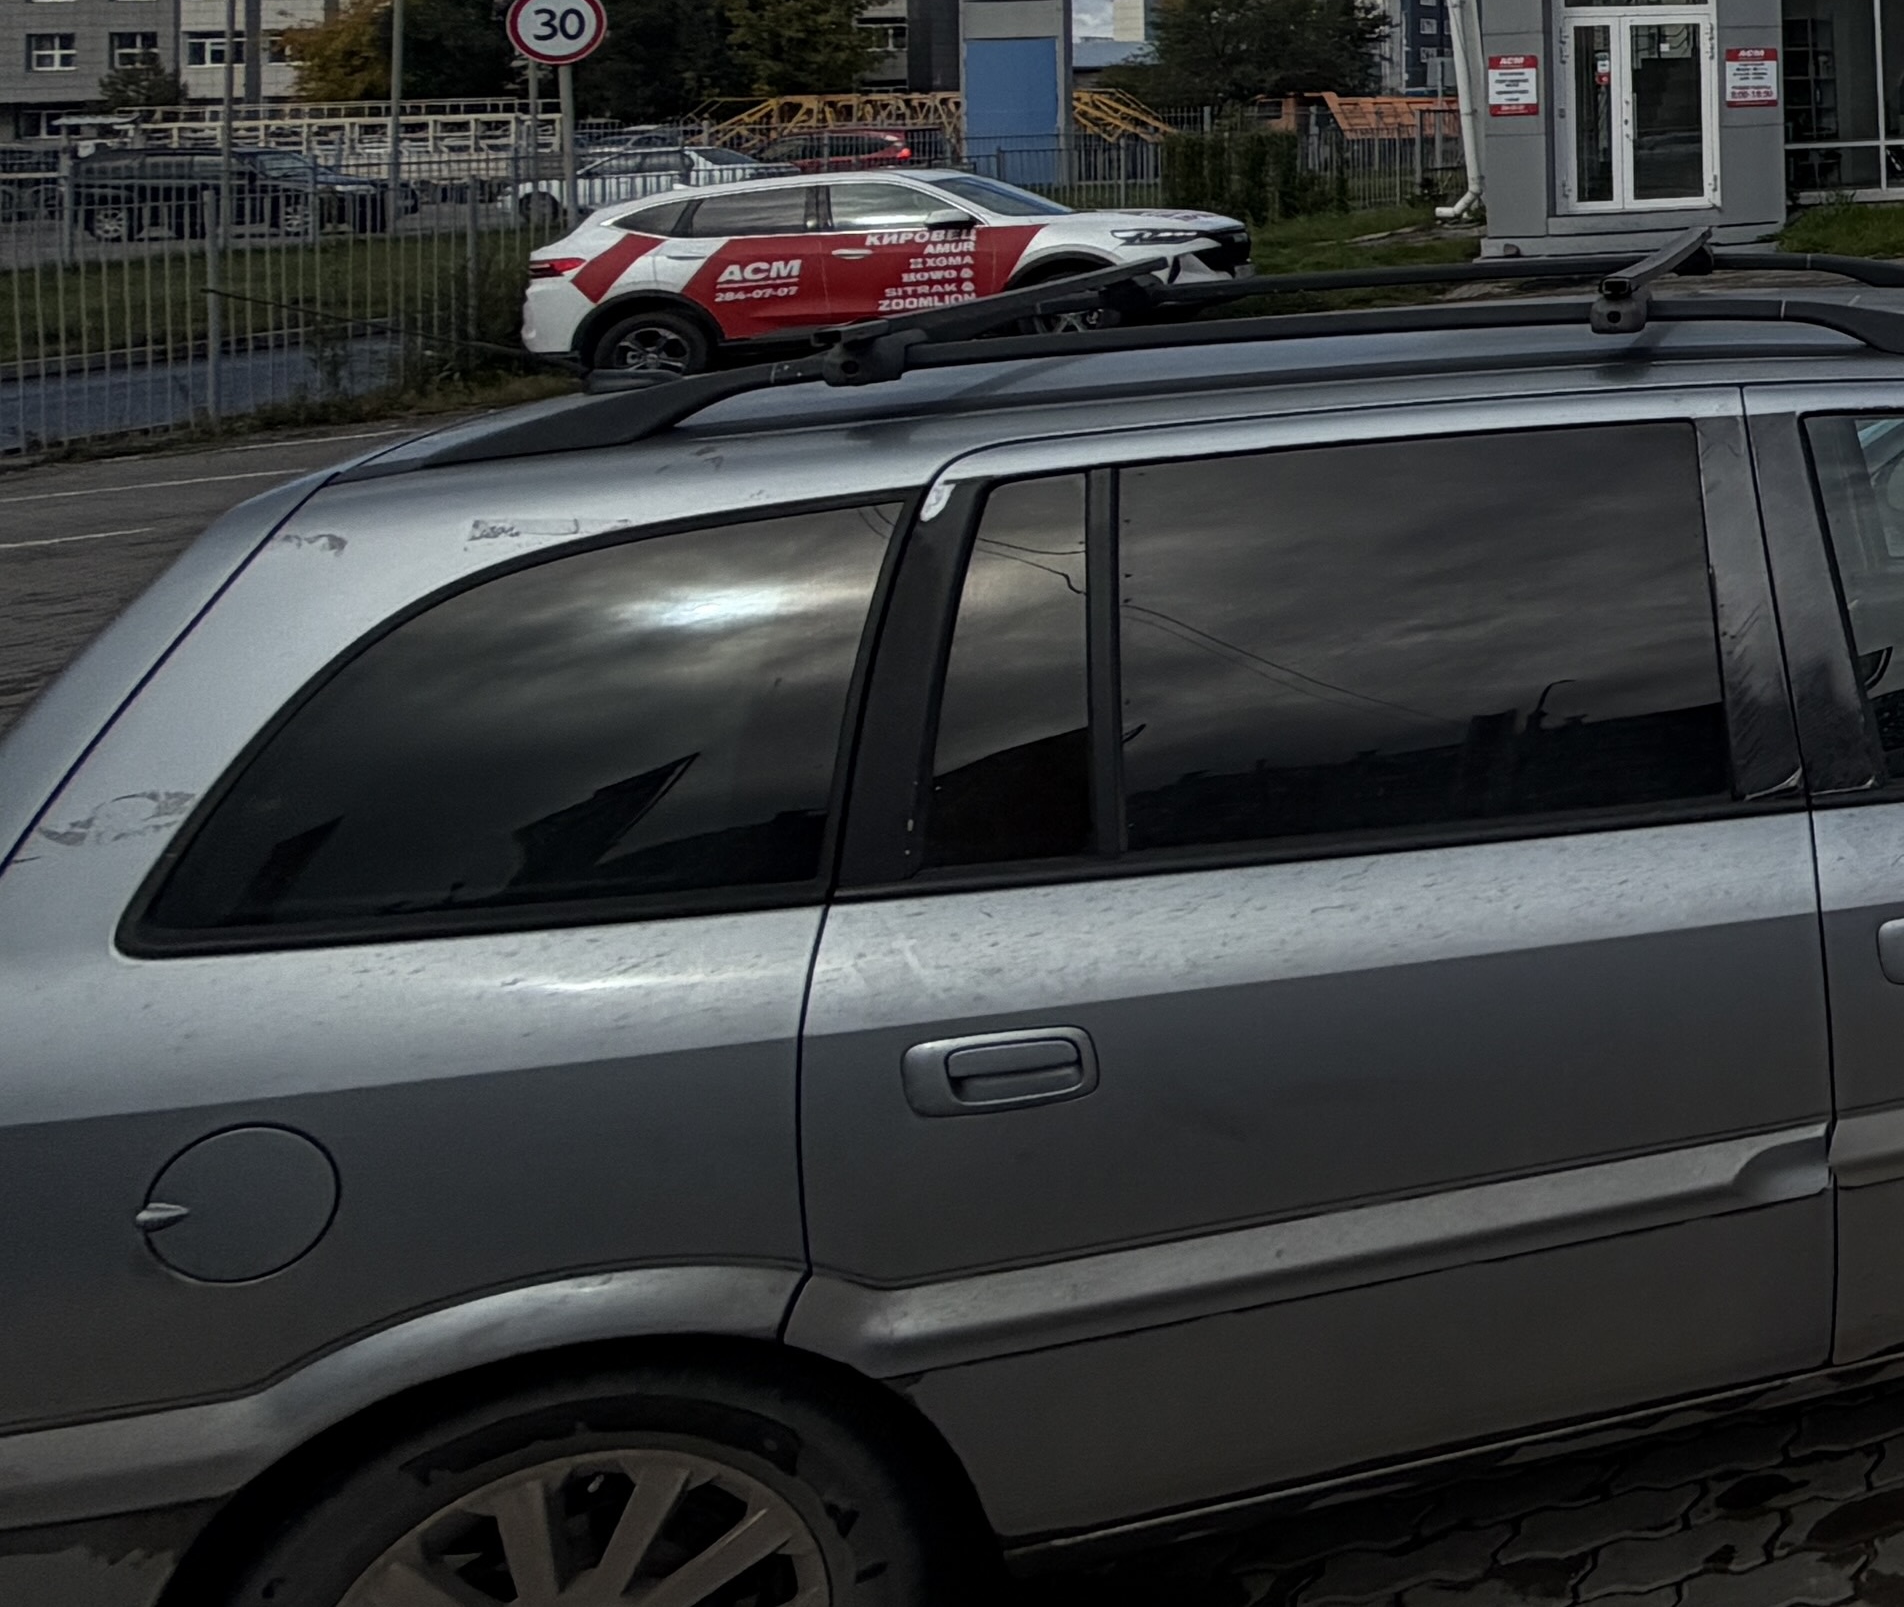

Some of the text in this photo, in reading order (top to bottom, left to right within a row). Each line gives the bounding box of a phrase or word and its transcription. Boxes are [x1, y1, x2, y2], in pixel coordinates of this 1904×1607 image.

[533, 8, 586, 41] 30
[865, 228, 977, 246] КИРОВЕЦ
[923, 241, 975, 255] AMUR
[925, 255, 974, 267] XGMA
[902, 269, 957, 282] HOWO
[714, 286, 799, 303] 284-07-07
[884, 284, 958, 297] SITRAK
[877, 292, 976, 311] ZOOMLION
